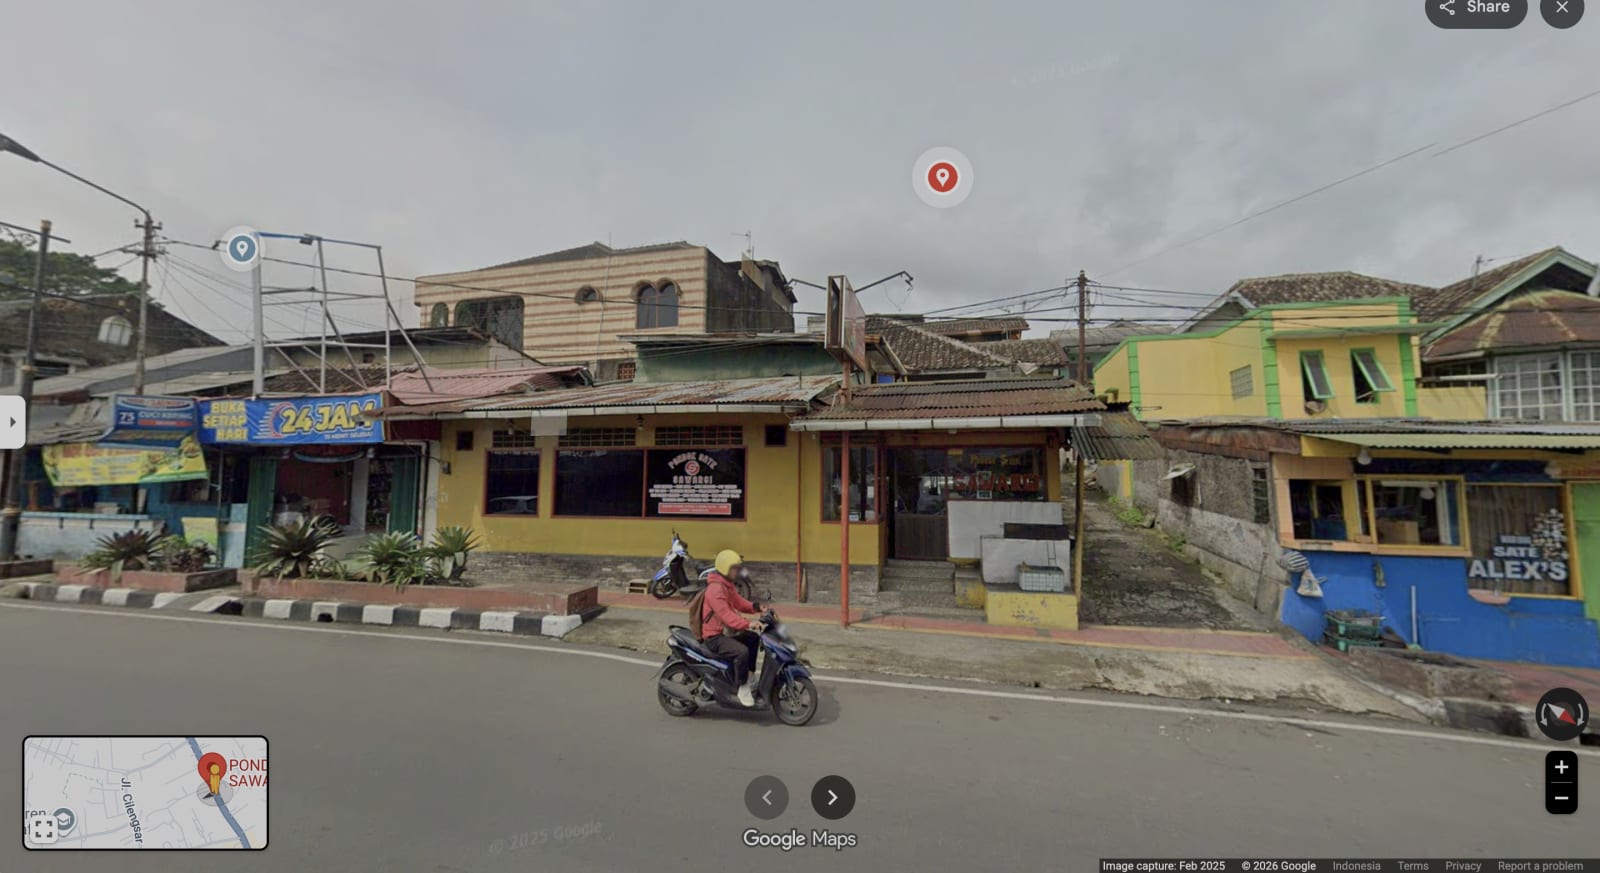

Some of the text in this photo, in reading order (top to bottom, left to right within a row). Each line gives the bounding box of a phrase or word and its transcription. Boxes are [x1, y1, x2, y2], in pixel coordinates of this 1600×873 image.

[211, 401, 246, 413] BUKA
[203, 414, 247, 428] SETIAP
[280, 400, 375, 434] 24 JAM
[216, 428, 249, 441] HARI
[1493, 546, 1539, 558] SATE
[1468, 559, 1567, 580] ALEX'S
